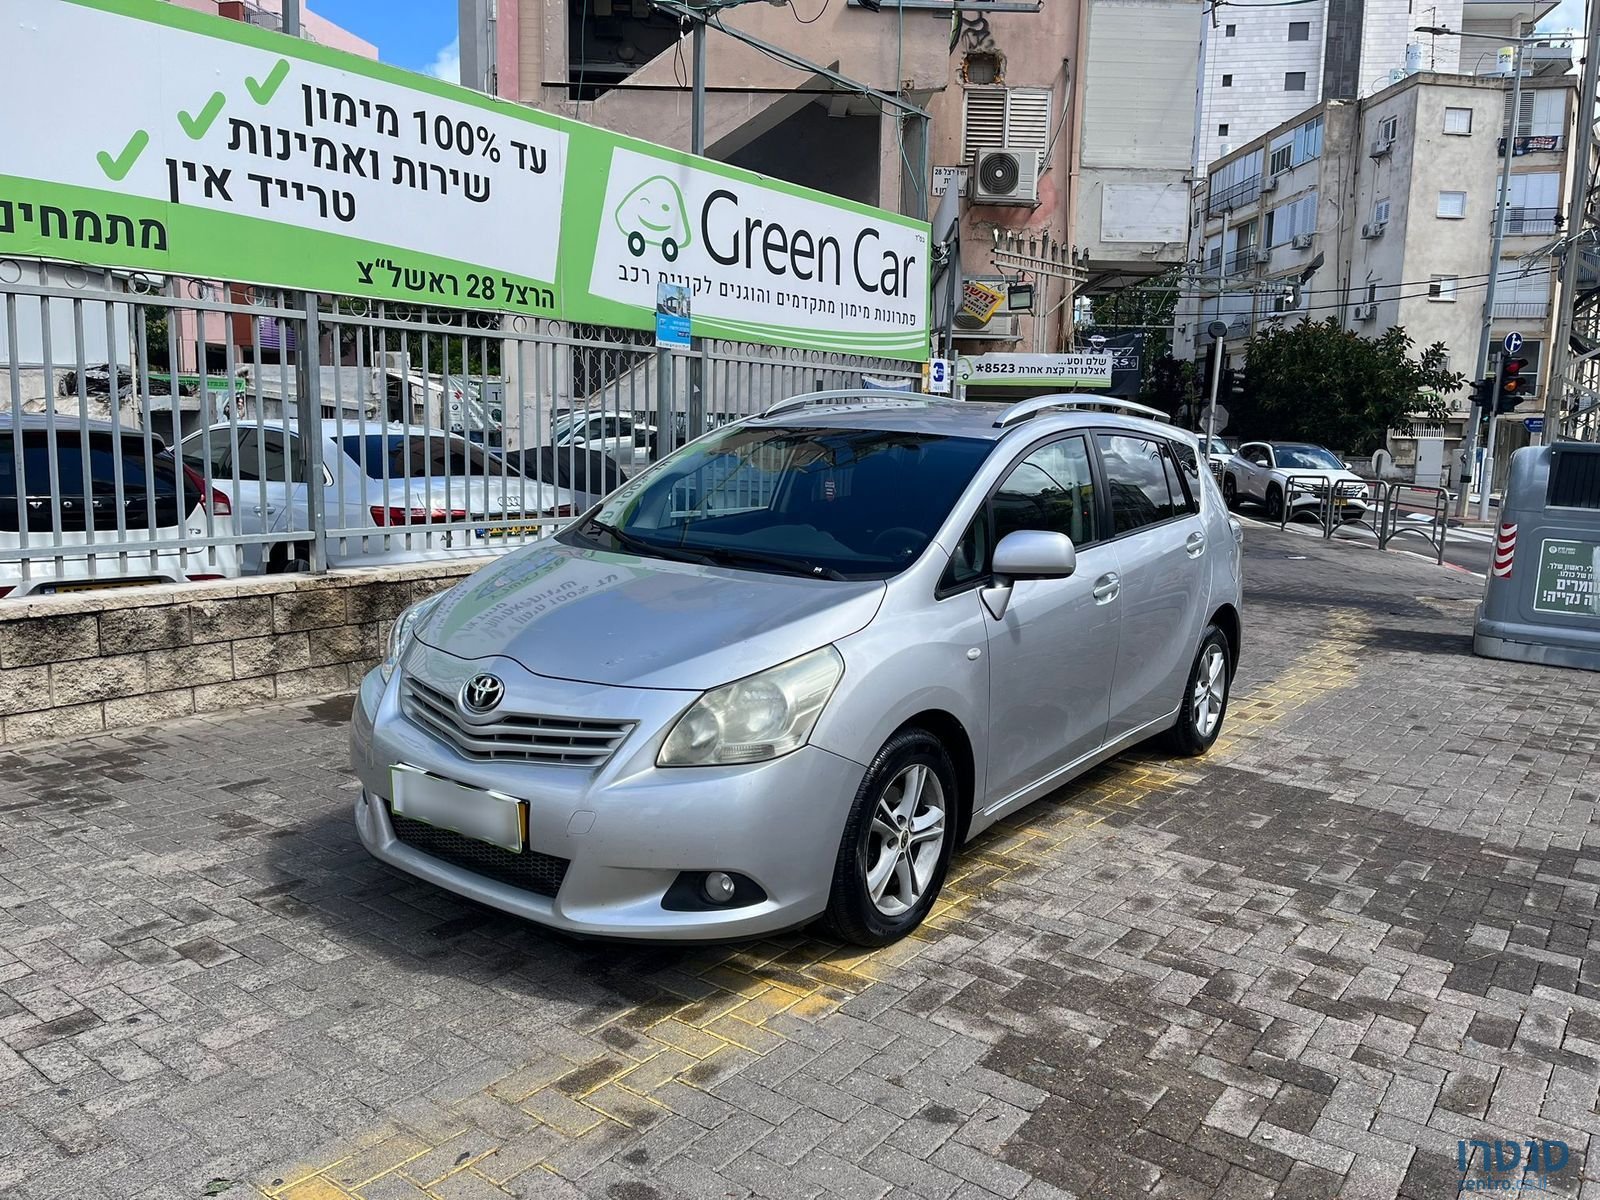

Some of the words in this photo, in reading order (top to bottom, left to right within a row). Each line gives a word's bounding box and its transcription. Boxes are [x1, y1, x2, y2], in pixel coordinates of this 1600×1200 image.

[302, 84, 398, 137] מימון
[228, 118, 379, 180] ואמינות
[414, 111, 500, 162] 100%
[511, 141, 546, 173] עד
[166, 158, 232, 204] אין
[393, 156, 489, 202] שירות
[248, 173, 355, 221] טרייד
[702, 190, 840, 285] Green
[854, 228, 915, 298] Car
[357, 258, 458, 295] ראשל"צ
[466, 274, 494, 300] 28
[619, 265, 649, 284] רכב
[502, 278, 554, 309] הרצל
[720, 283, 769, 303] והוגנים
[778, 292, 834, 314] מתקדמים
[841, 303, 869, 318] מימון
[875, 309, 915, 325] פתרונות
[1018, 366, 1042, 374] אחרת
[1046, 366, 1064, 376] קצת
[1058, 358, 1083, 366] וסע...
[1543, 590, 1580, 605] נקייה!
